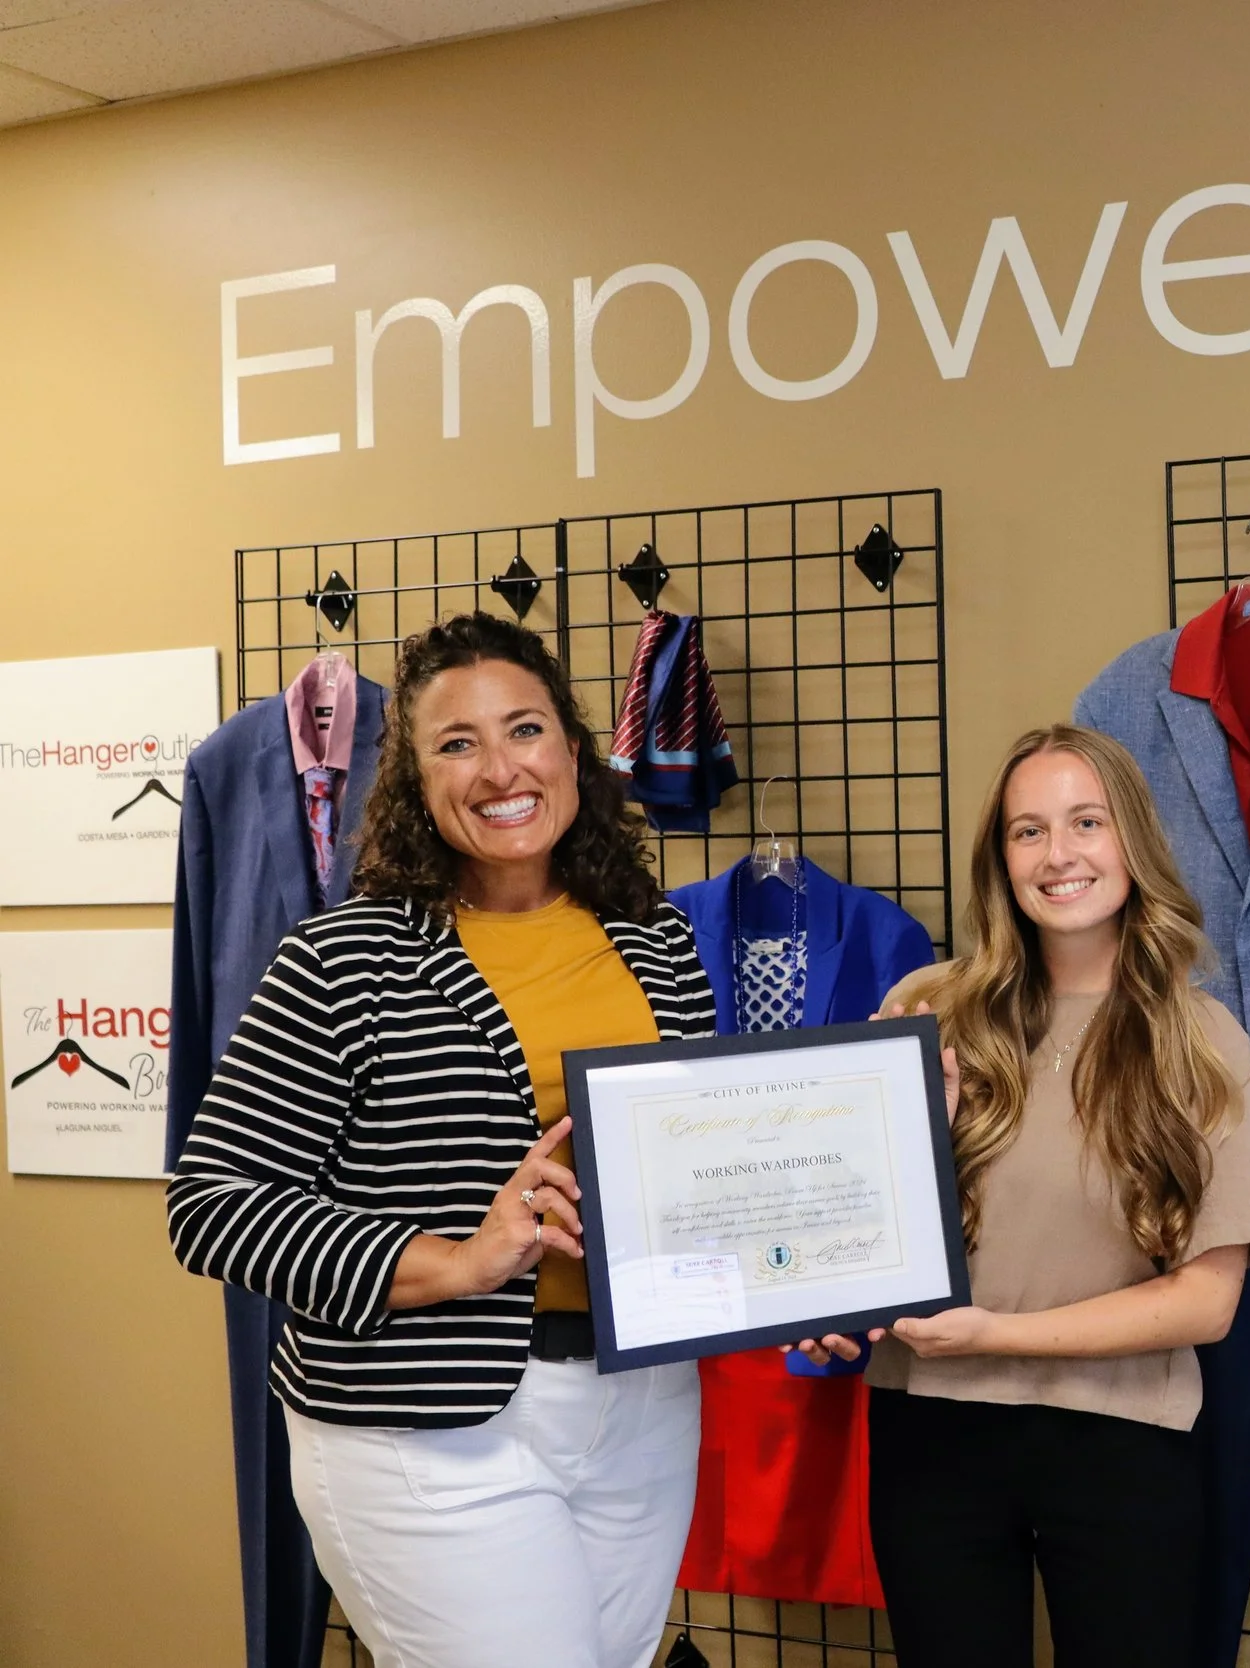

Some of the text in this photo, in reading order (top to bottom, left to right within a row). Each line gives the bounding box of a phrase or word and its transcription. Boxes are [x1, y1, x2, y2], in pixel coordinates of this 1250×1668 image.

[132, 770, 166, 779] WORKING
[78, 831, 105, 842] COSTA
[105, 831, 128, 841] MESA
[136, 829, 170, 840] GARDEN
[23, 1005, 52, 1036] The
[713, 1080, 807, 1100] CITY OF IRVINE
[47, 1101, 97, 1112] POWERING
[100, 1102, 146, 1113] WORKING
[93, 1124, 123, 1134] NIGUEL
[692, 1152, 843, 1180] WORKING WARDROBES
